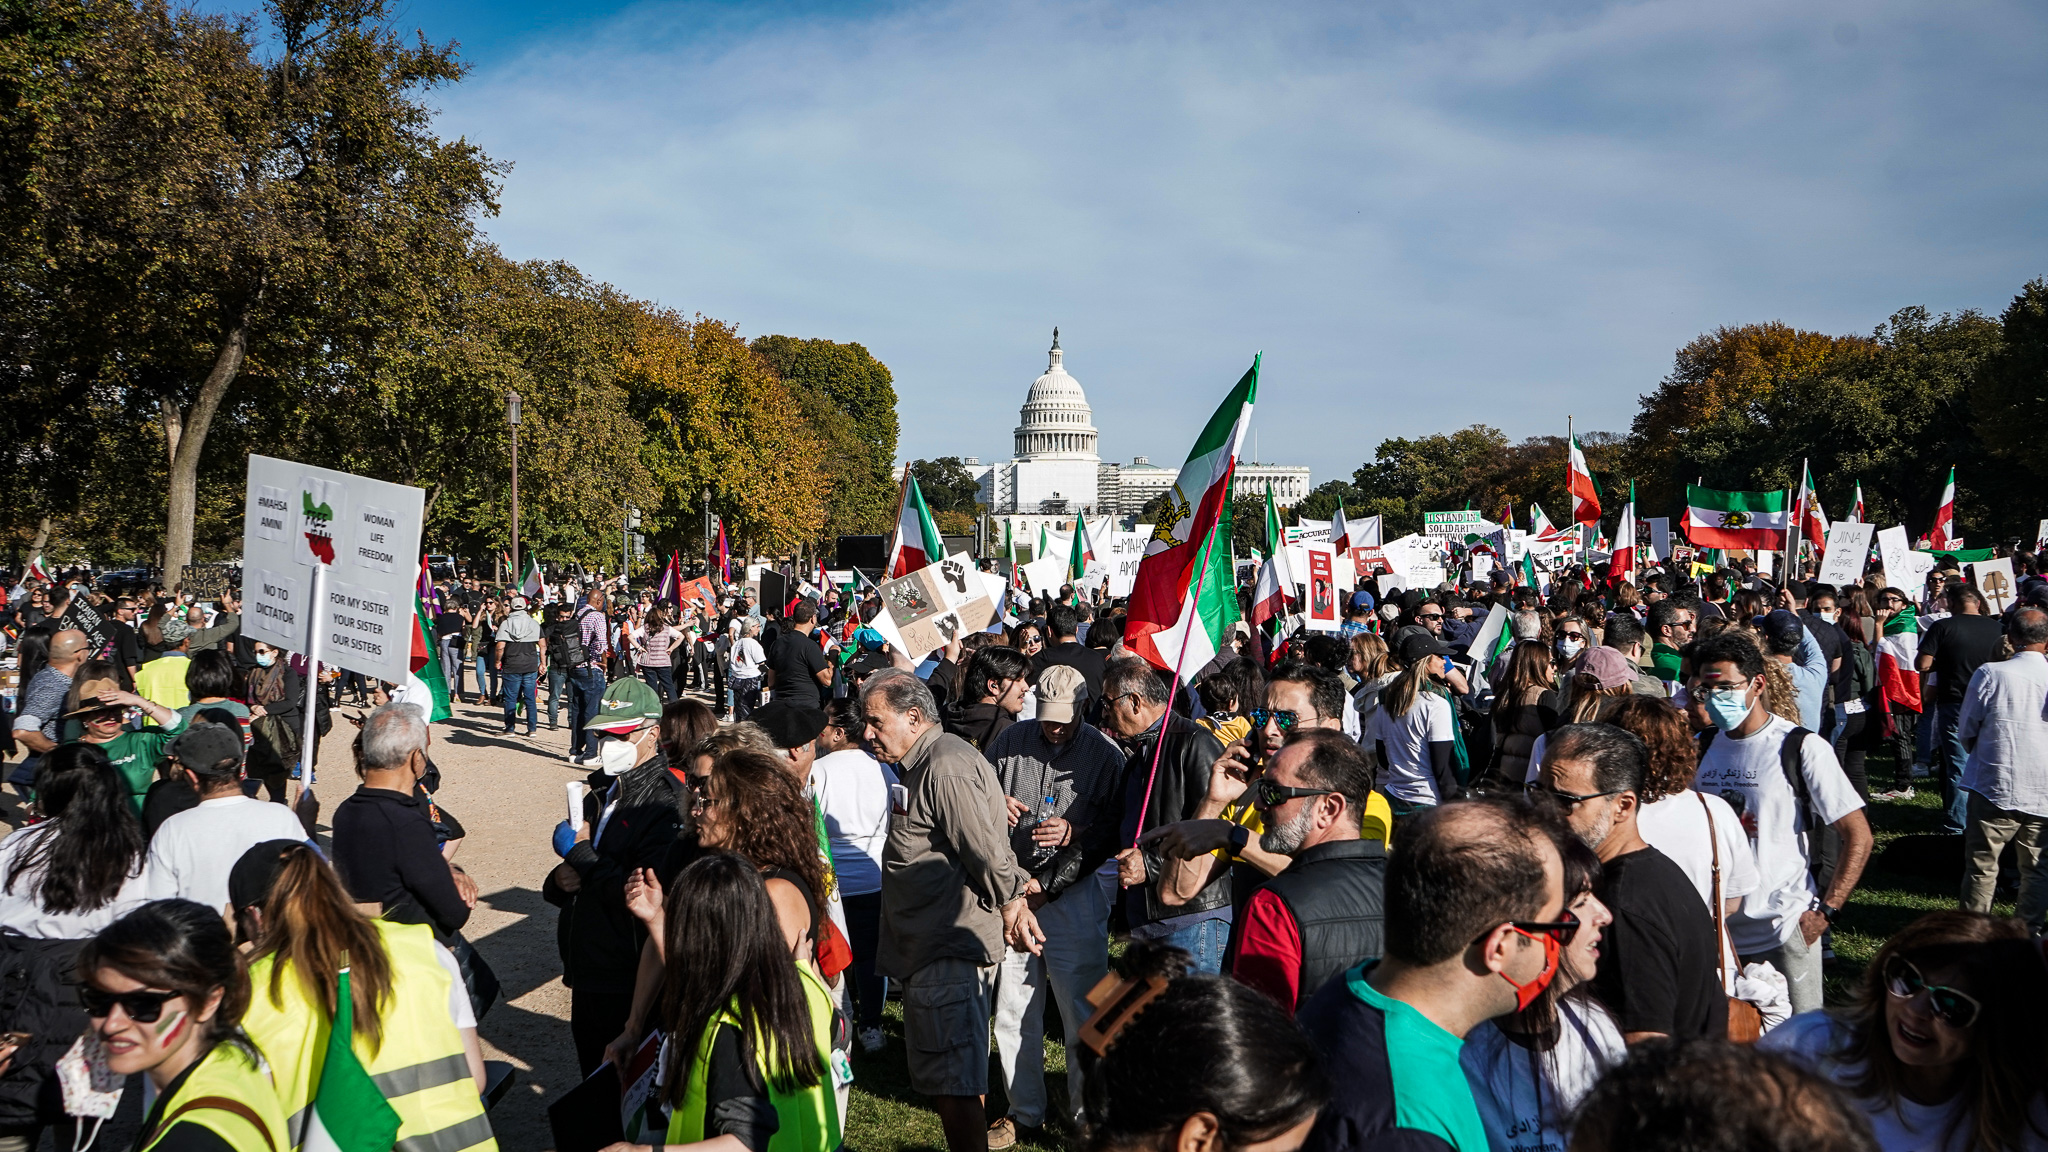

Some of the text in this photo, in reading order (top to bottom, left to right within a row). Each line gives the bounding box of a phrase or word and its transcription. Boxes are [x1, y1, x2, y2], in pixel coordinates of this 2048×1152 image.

[257, 496, 288, 512] #MAHSA
[260, 516, 283, 531] AMINI
[304, 509, 329, 528] FREE
[363, 512, 395, 529] WOMAN
[1428, 513, 1476, 522] I STAND IN
[1299, 528, 1332, 540] ACCURAT
[1428, 524, 1480, 533] SOLIDARI
[309, 528, 332, 548] IRAN
[370, 532, 385, 544] LIFE
[1112, 538, 1149, 554] #MAHS
[1834, 531, 1863, 546] JINA,
[358, 546, 394, 564] FREEDOM
[1358, 549, 1385, 560] WOME
[1119, 560, 1140, 576] AMI
[1829, 572, 1845, 580] me
[263, 583, 288, 601] NO TO
[330, 592, 389, 616] FOR MY SISTER
[256, 602, 294, 625] DICTATOR
[333, 613, 384, 636] YOUR SISTER
[332, 633, 382, 656] OUR SISTERS
